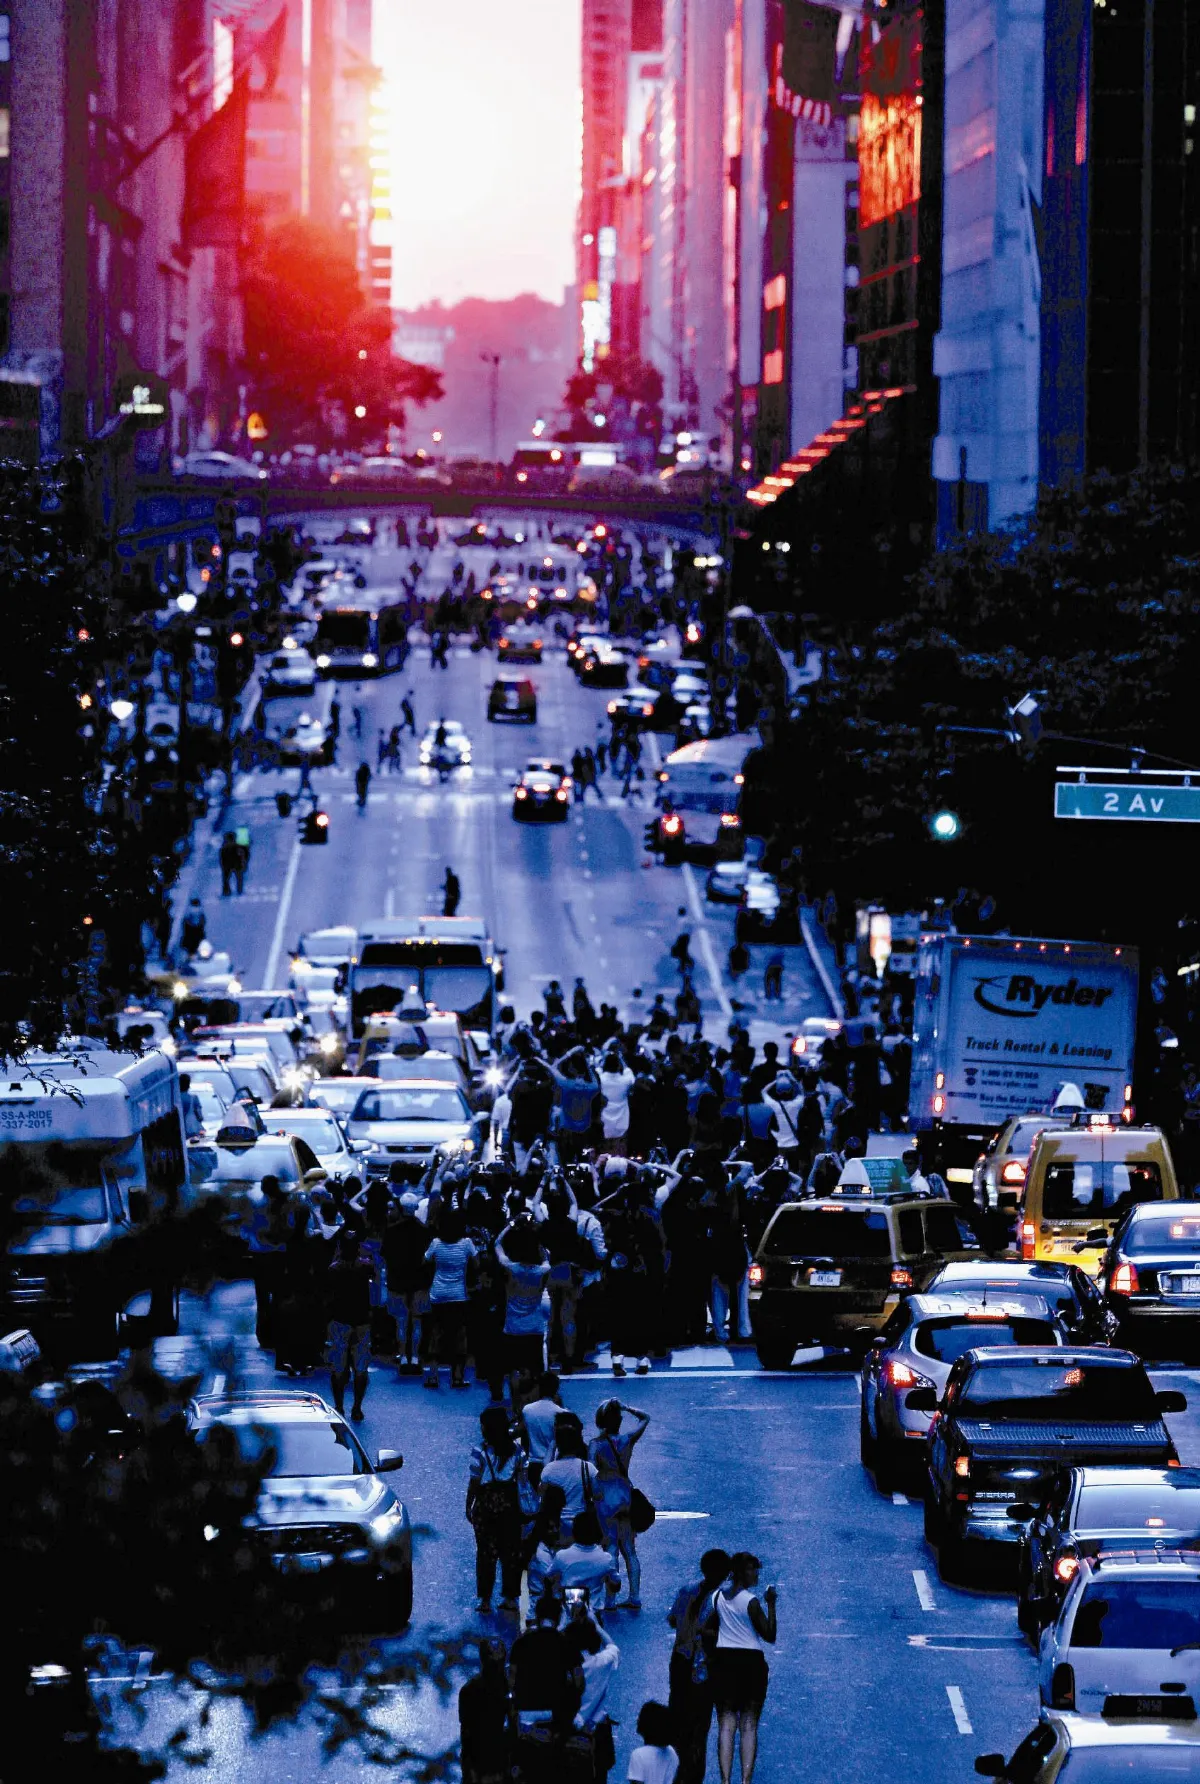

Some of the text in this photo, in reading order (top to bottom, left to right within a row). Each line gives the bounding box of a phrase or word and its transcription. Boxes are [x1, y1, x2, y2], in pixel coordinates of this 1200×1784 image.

[1103, 792, 1164, 813] 2 Av
[1005, 975, 1114, 1010] Ryder
[966, 1037, 1112, 1059] Truck Rental & Leasing
[0, 1119, 53, 1129] -337-2017
[975, 1491, 1017, 1499] SIERRA
